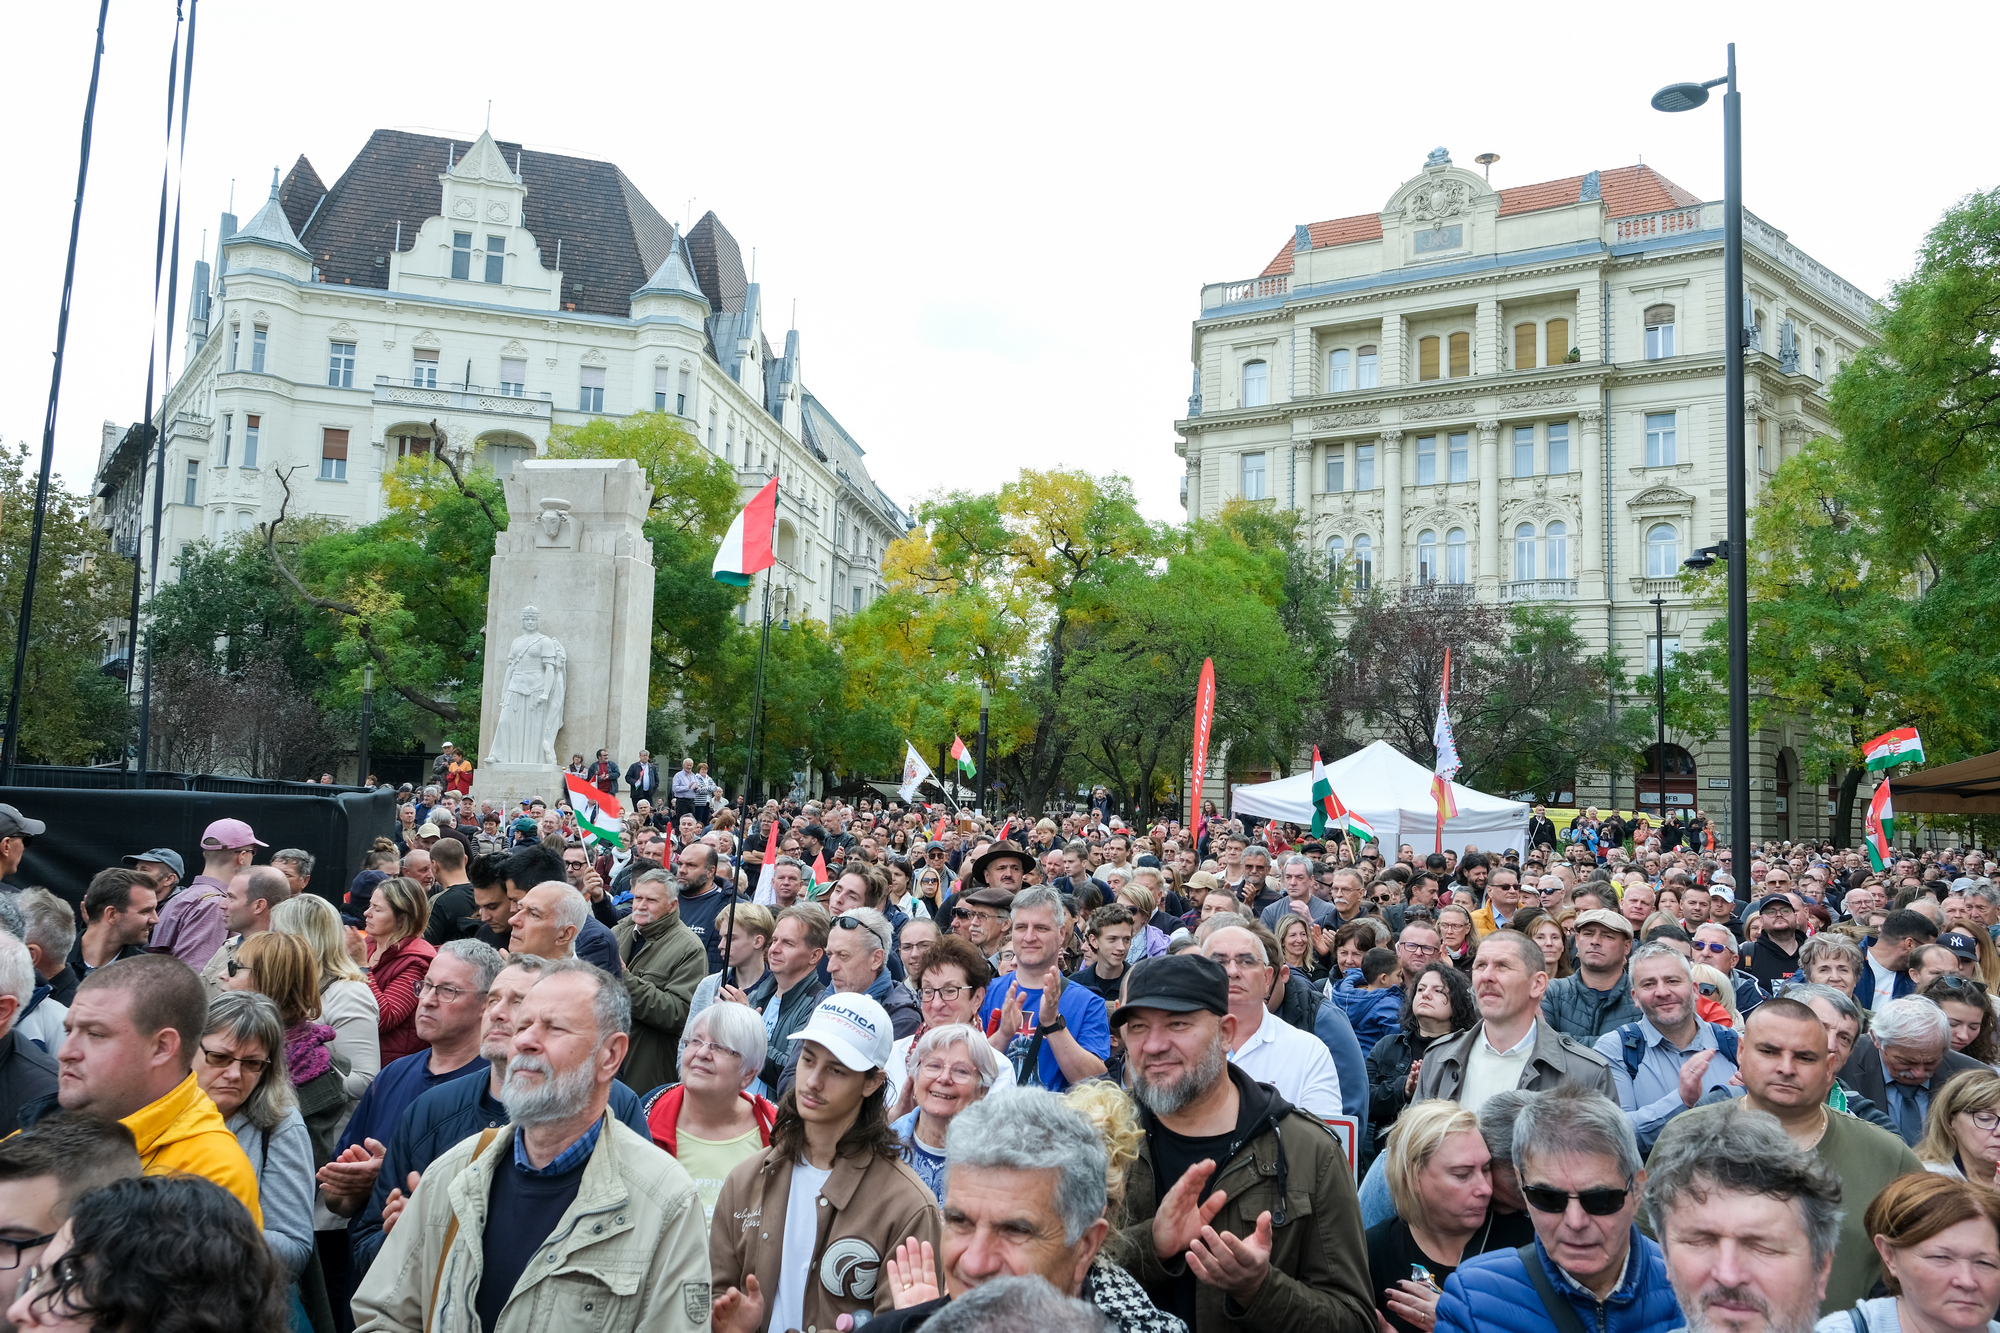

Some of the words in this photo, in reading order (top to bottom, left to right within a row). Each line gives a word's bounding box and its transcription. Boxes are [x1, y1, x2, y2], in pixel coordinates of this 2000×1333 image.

[1195, 677, 1211, 795] mandiner
[1950, 935, 1964, 947] NY
[816, 1013, 873, 1041] COMPETITION
[820, 1003, 876, 1033] NAUTICA
